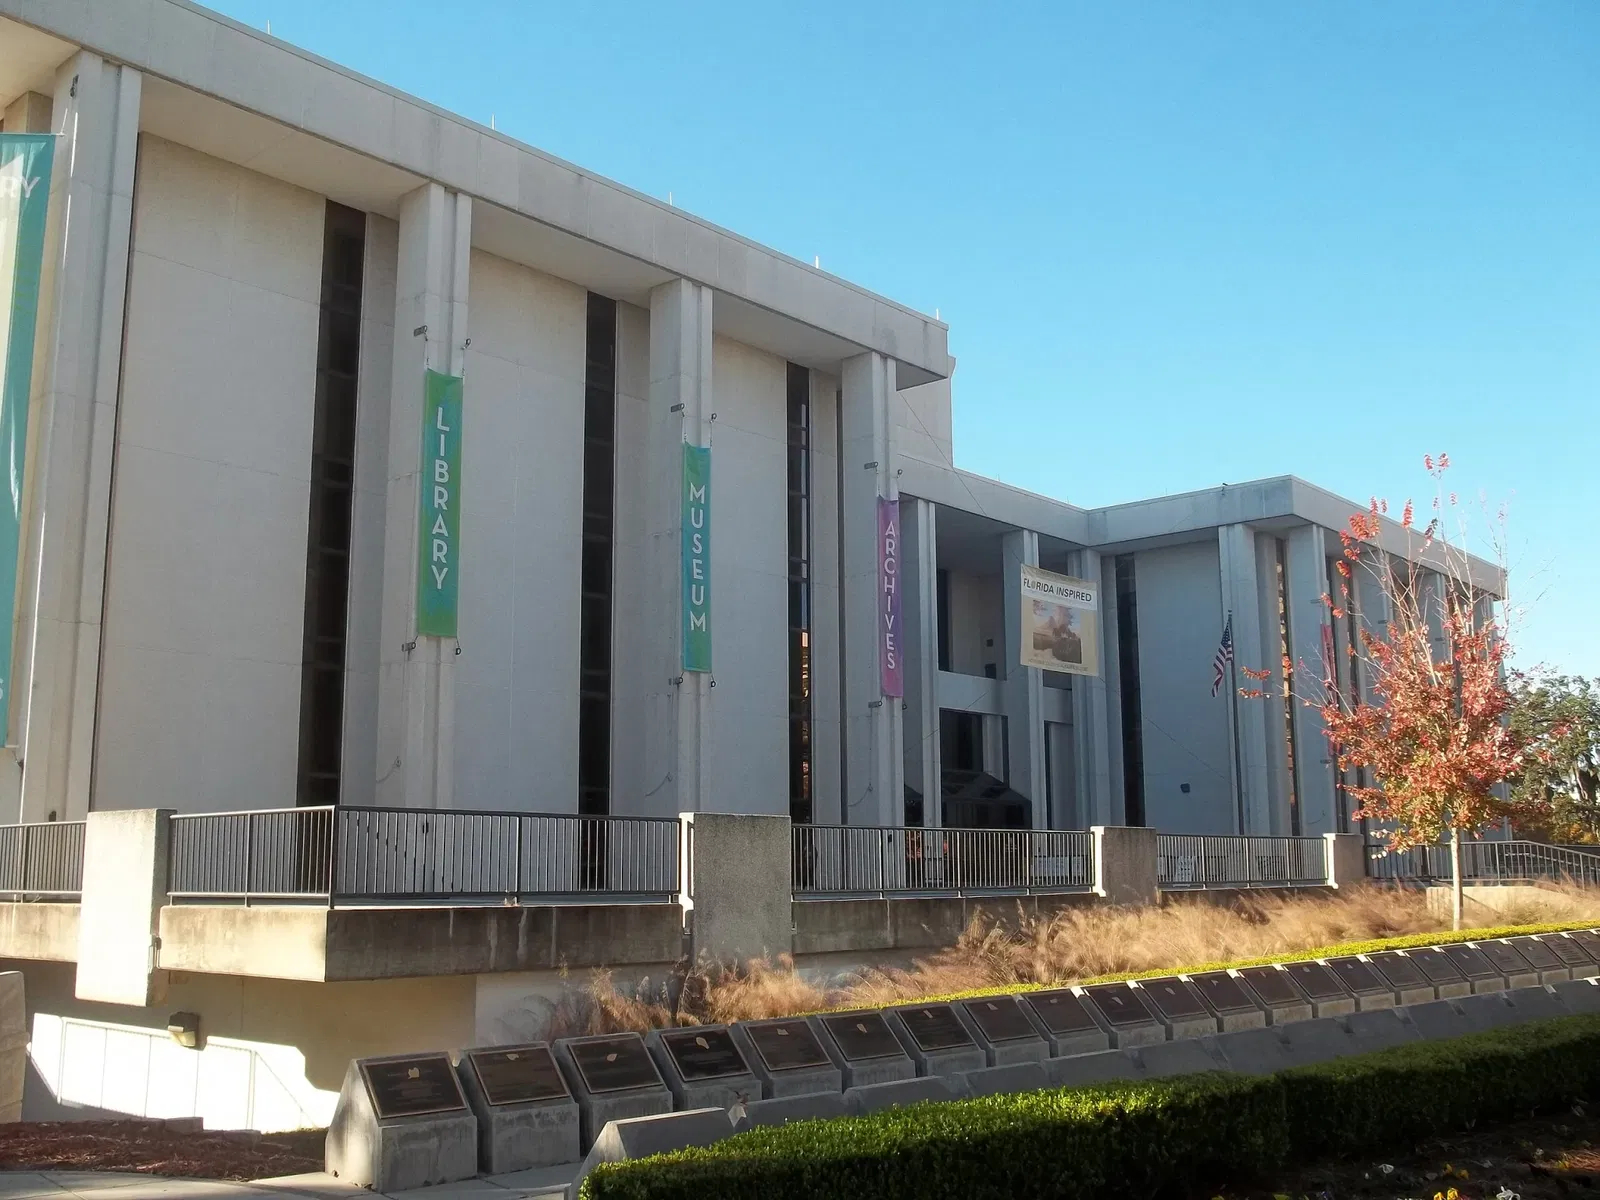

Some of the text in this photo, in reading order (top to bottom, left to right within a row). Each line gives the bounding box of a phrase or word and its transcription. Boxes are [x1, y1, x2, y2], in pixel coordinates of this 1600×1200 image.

[431, 406, 450, 590] LIBRARY
[690, 482, 706, 632] MUSEUM
[884, 521, 896, 669] ARCHIVES
[1023, 578, 1054, 594] FLORIDA
[1056, 586, 1092, 602] INSPIRED
